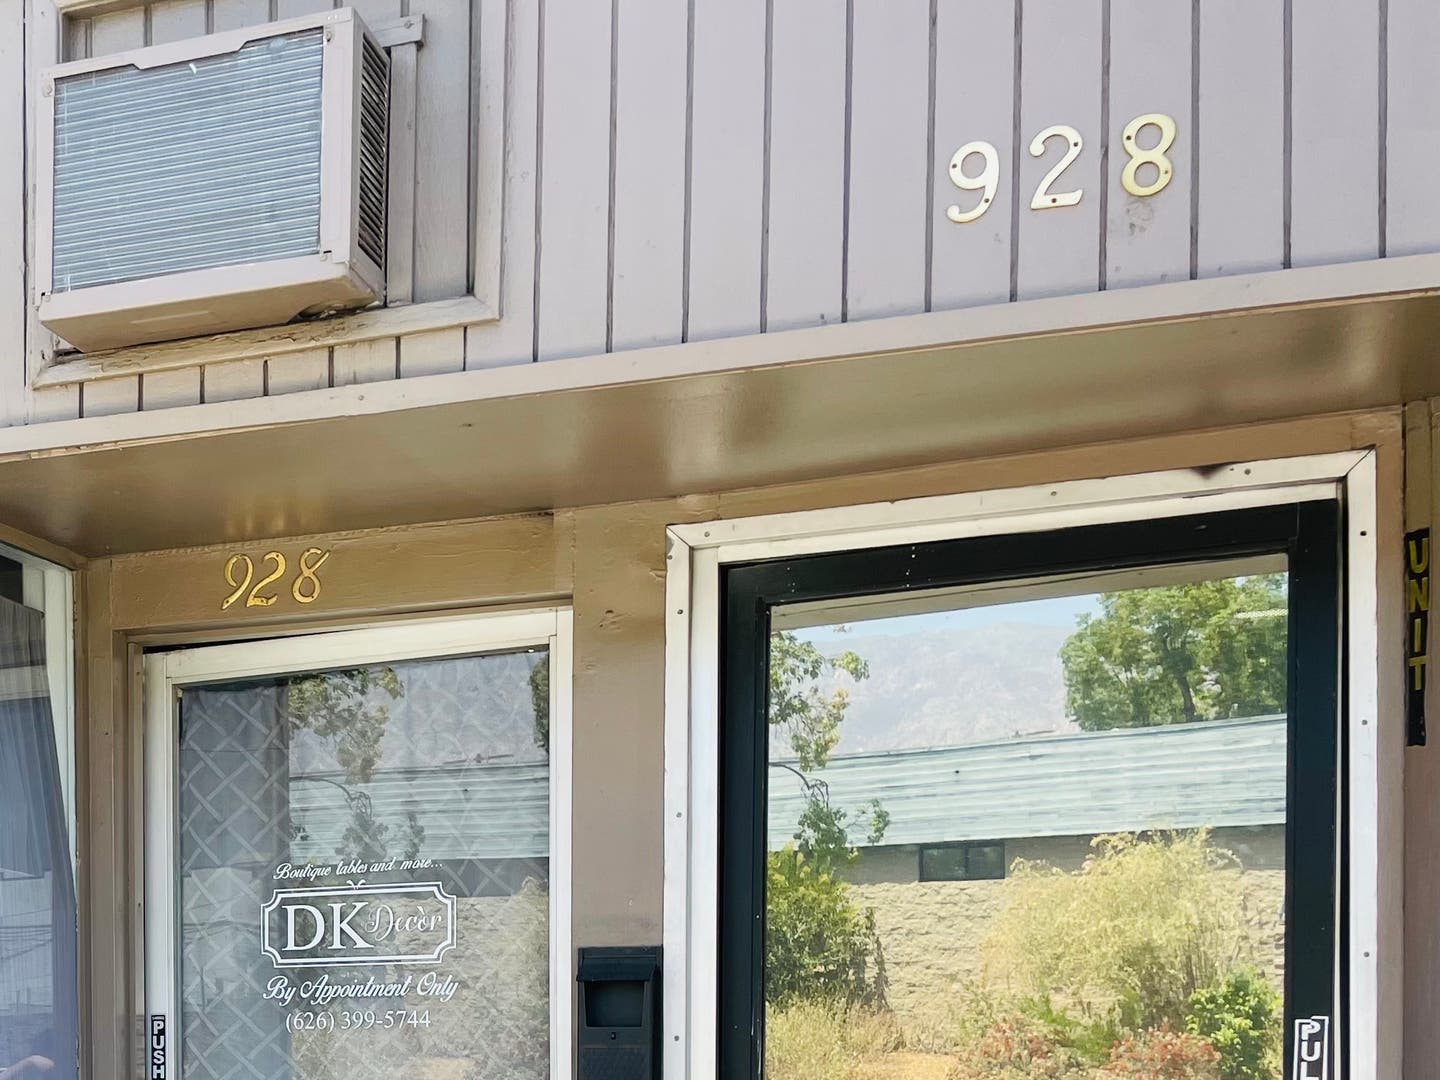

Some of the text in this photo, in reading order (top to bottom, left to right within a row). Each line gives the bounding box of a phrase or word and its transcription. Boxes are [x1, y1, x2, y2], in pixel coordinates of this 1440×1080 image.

[946, 113, 1177, 223] 928
[221, 547, 330, 610] 928
[1409, 537, 1430, 691] UNIT
[273, 862, 331, 881] Boutique
[336, 860, 368, 874] tables
[370, 857, 395, 873] and
[282, 901, 374, 951] DK
[263, 971, 459, 1006] By Appointment Only
[285, 1010, 431, 1033] (626) 399-5744
[152, 1020, 165, 1079] PUSH
